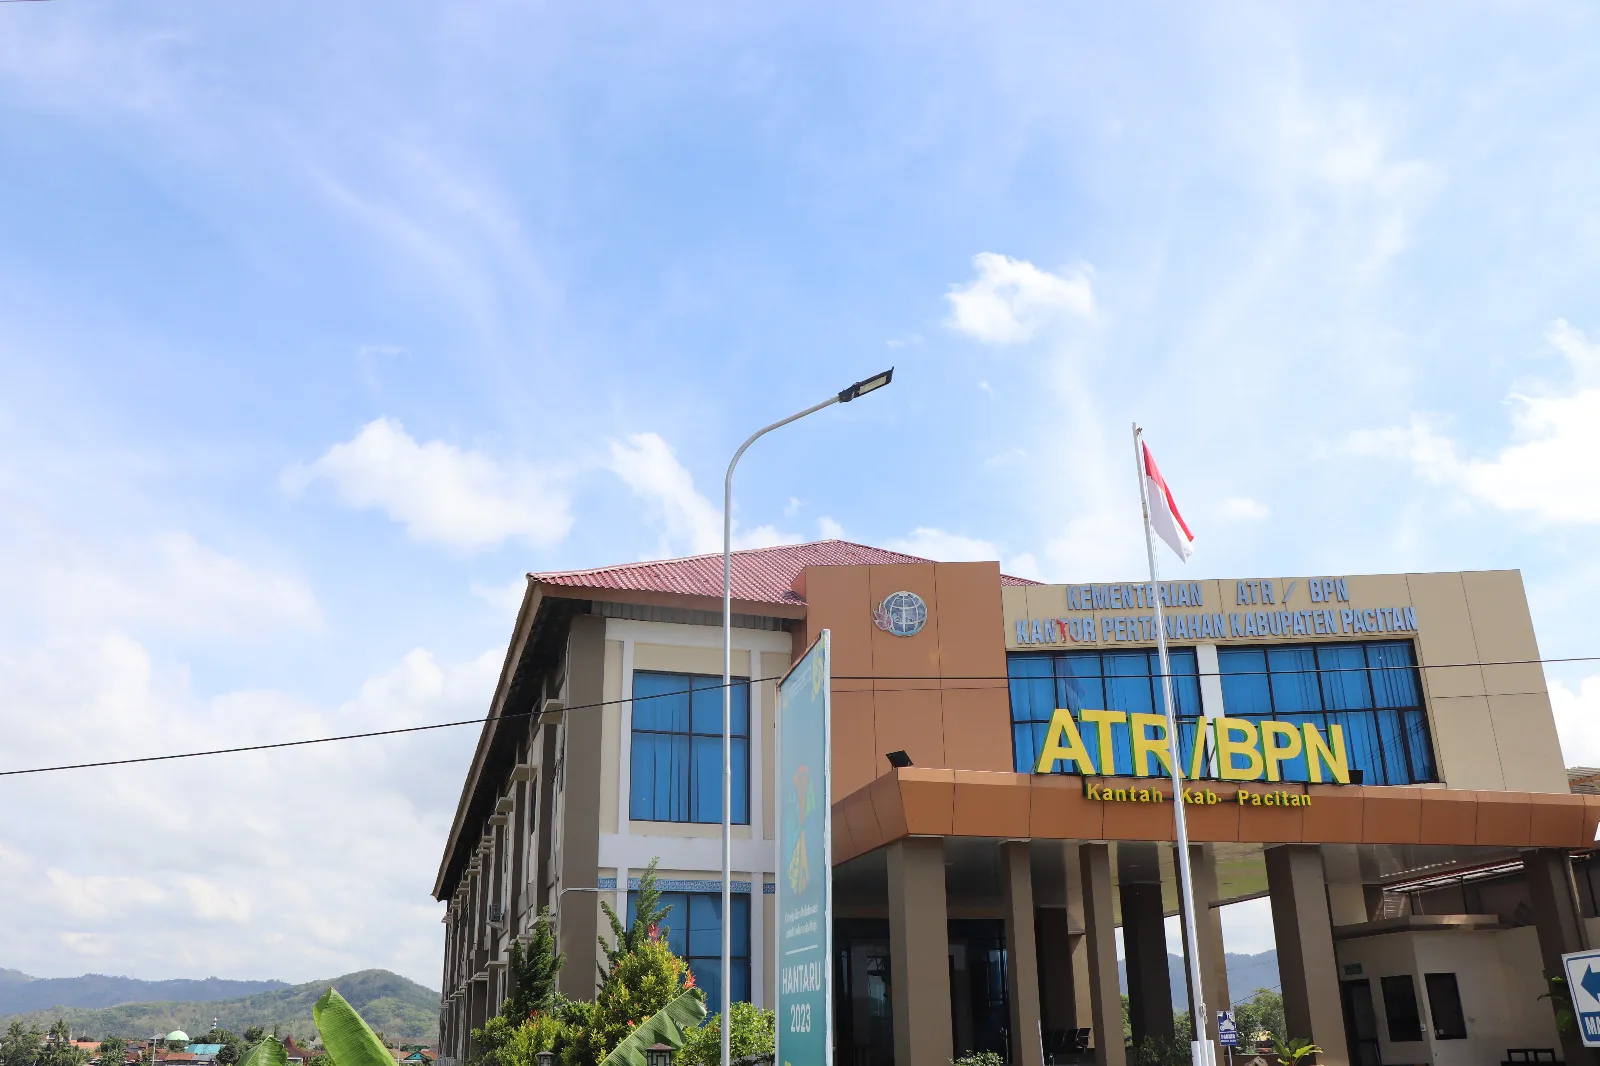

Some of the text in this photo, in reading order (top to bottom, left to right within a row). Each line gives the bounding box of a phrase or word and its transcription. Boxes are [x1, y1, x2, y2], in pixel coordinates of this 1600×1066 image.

[1066, 582, 1203, 610] KEMENTERIAN
[1236, 580, 1275, 605] ATR
[1308, 578, 1349, 603] BPN
[1016, 617, 1097, 644] KANTOR
[1229, 609, 1337, 637] KABUPATEN
[1340, 606, 1418, 634] PACITAN
[1086, 783, 1312, 806] Kantah Kab. Pacitan
[782, 961, 820, 995] HANTARU
[790, 1003, 811, 1033] 2023
